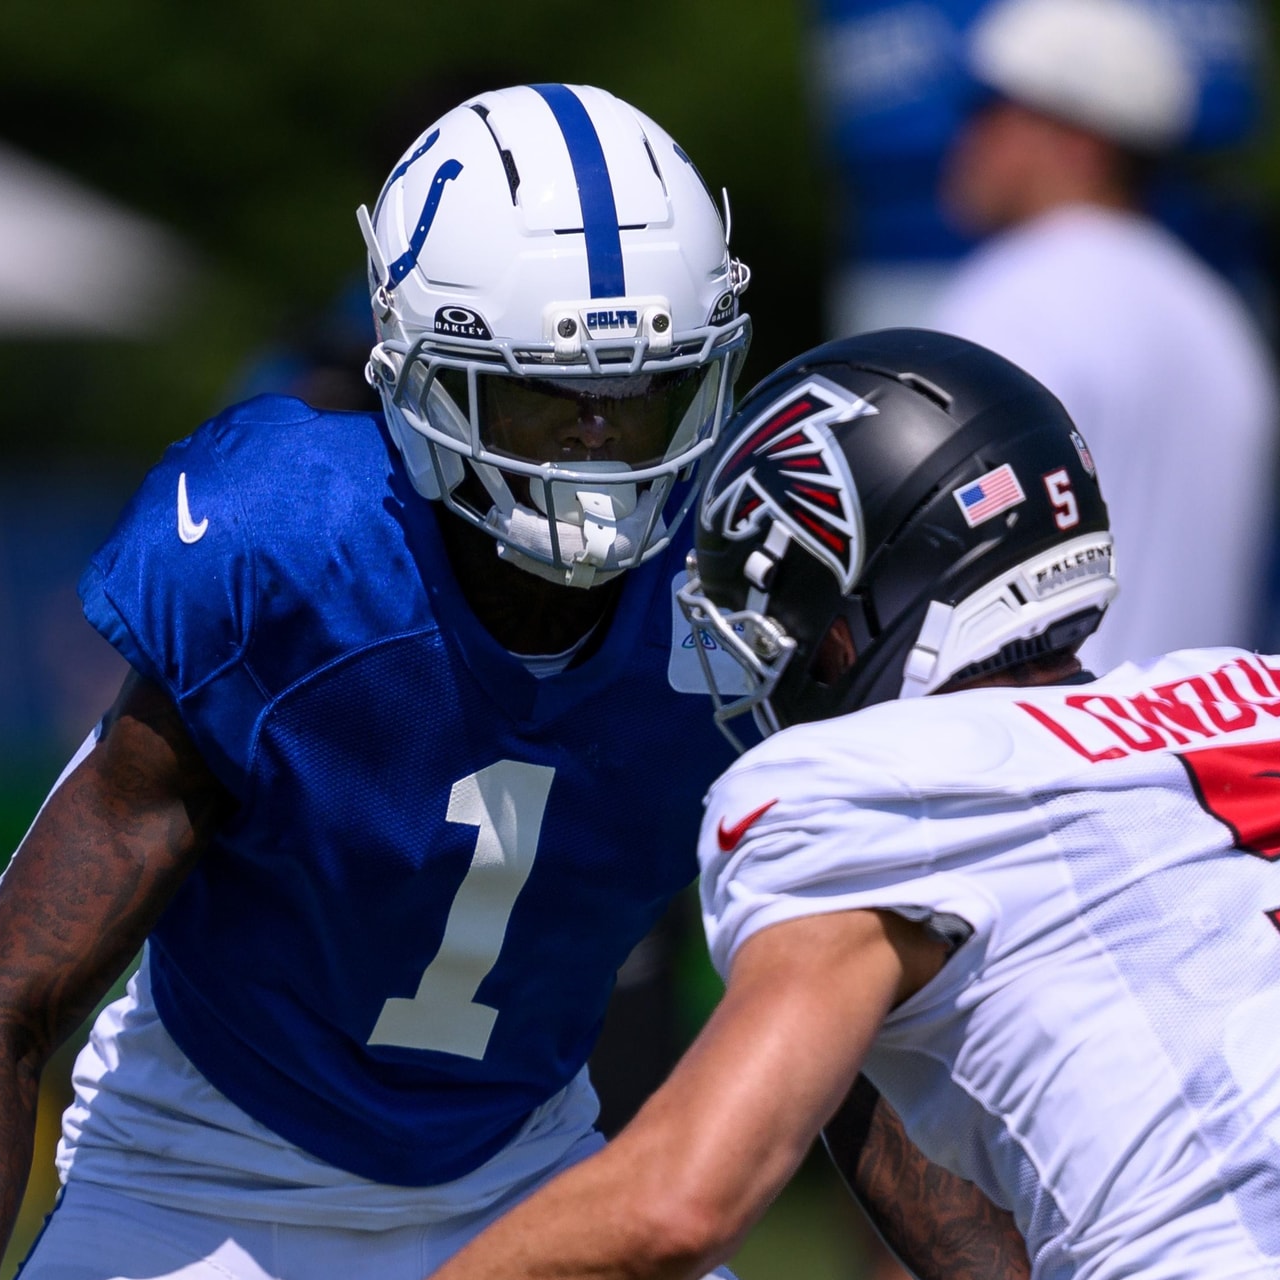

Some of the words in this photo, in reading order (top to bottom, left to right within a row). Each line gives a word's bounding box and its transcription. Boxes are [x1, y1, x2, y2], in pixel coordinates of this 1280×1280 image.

[435, 321, 484, 336] OAKLEY
[586, 310, 638, 330] COLTS
[1042, 467, 1080, 532] 5
[366, 759, 557, 1061] 1
